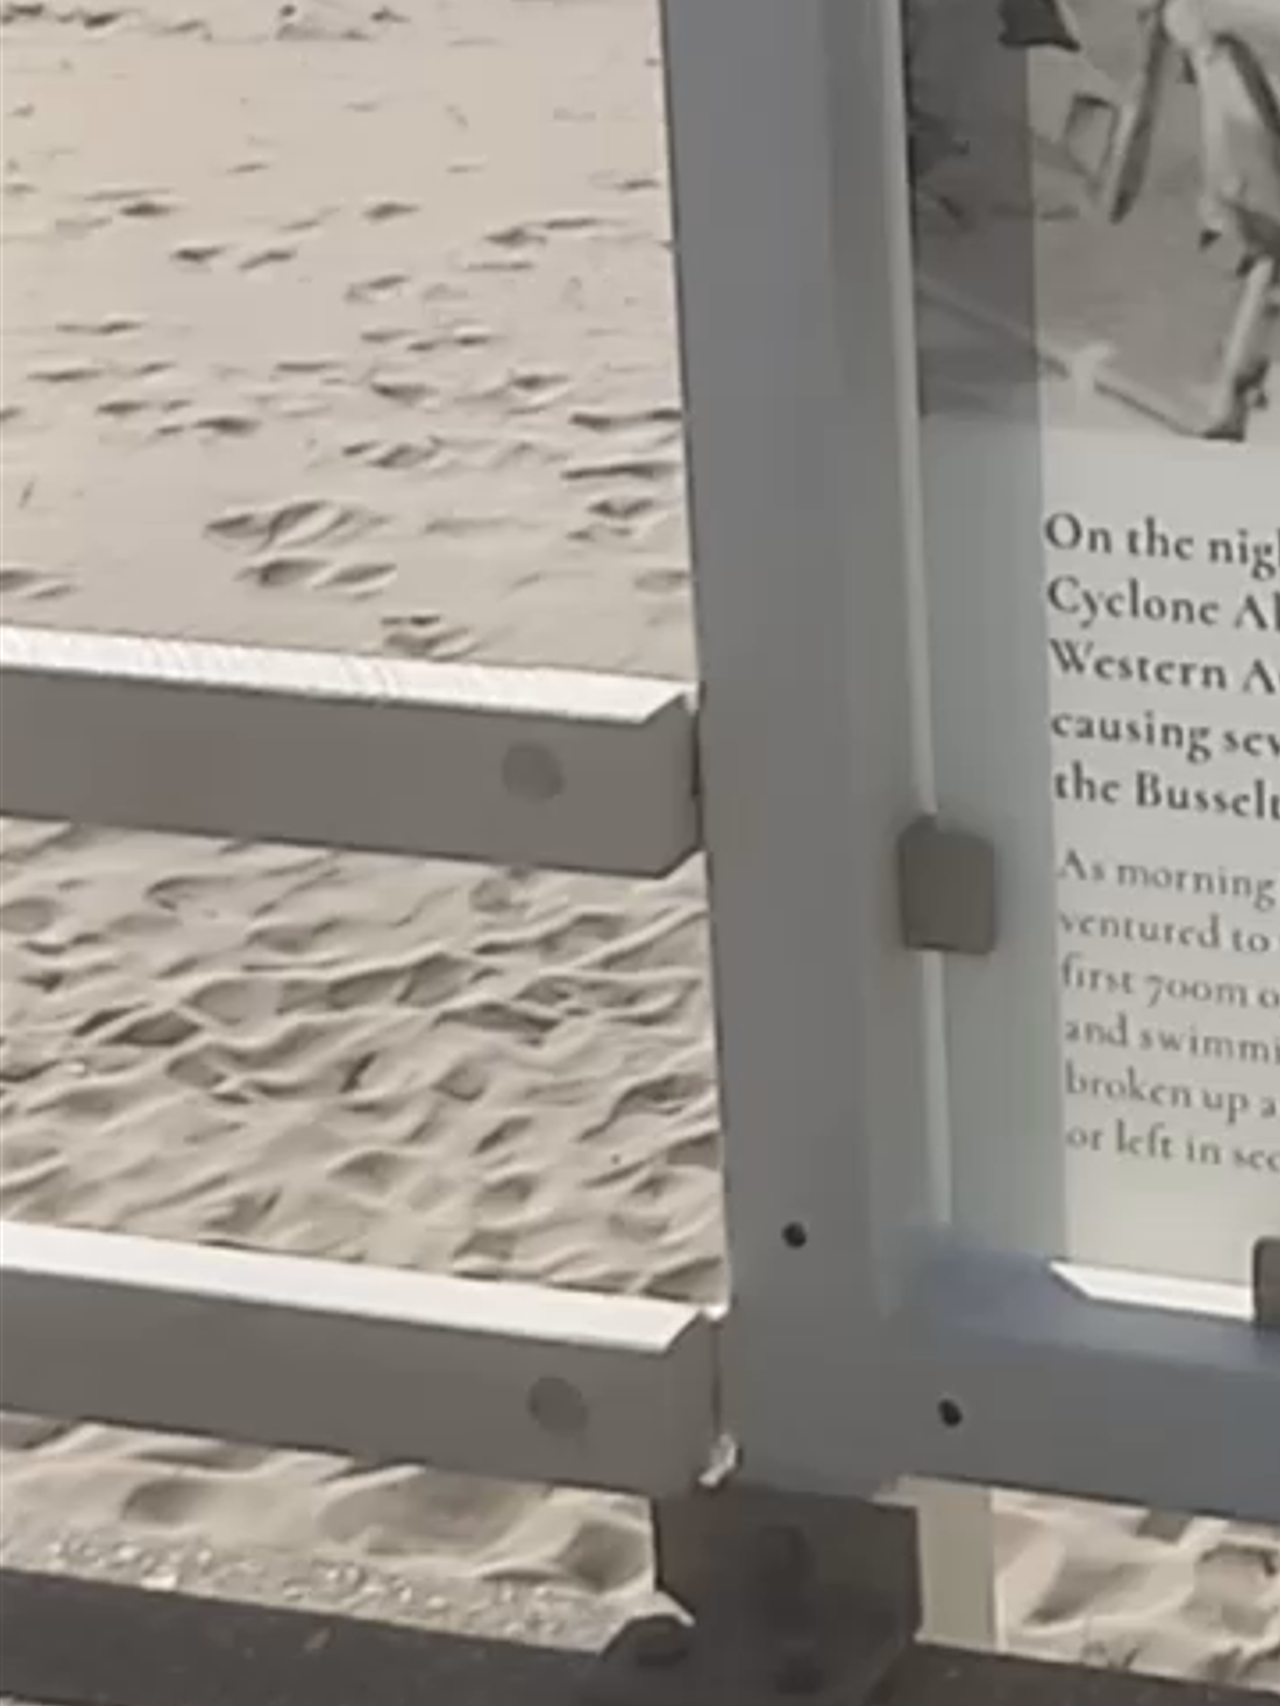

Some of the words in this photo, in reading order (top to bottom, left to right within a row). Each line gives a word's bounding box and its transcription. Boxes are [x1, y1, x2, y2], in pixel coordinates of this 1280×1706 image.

[1041, 511, 1114, 556] On
[1125, 514, 1196, 563] the
[1044, 574, 1221, 631] Cyclone
[1047, 635, 1229, 692] Western
[1049, 708, 1214, 766] causing
[1051, 758, 1122, 806] the
[1058, 847, 1107, 883] As
[1115, 863, 1277, 915] morning
[1058, 910, 1223, 952] ventured
[1229, 926, 1272, 956] to
[1062, 1057, 1194, 1110] broken
[1200, 1087, 1252, 1129] up
[1063, 1123, 1108, 1153] or
[1114, 1116, 1174, 1162] left
[1185, 1136, 1223, 1167] in
